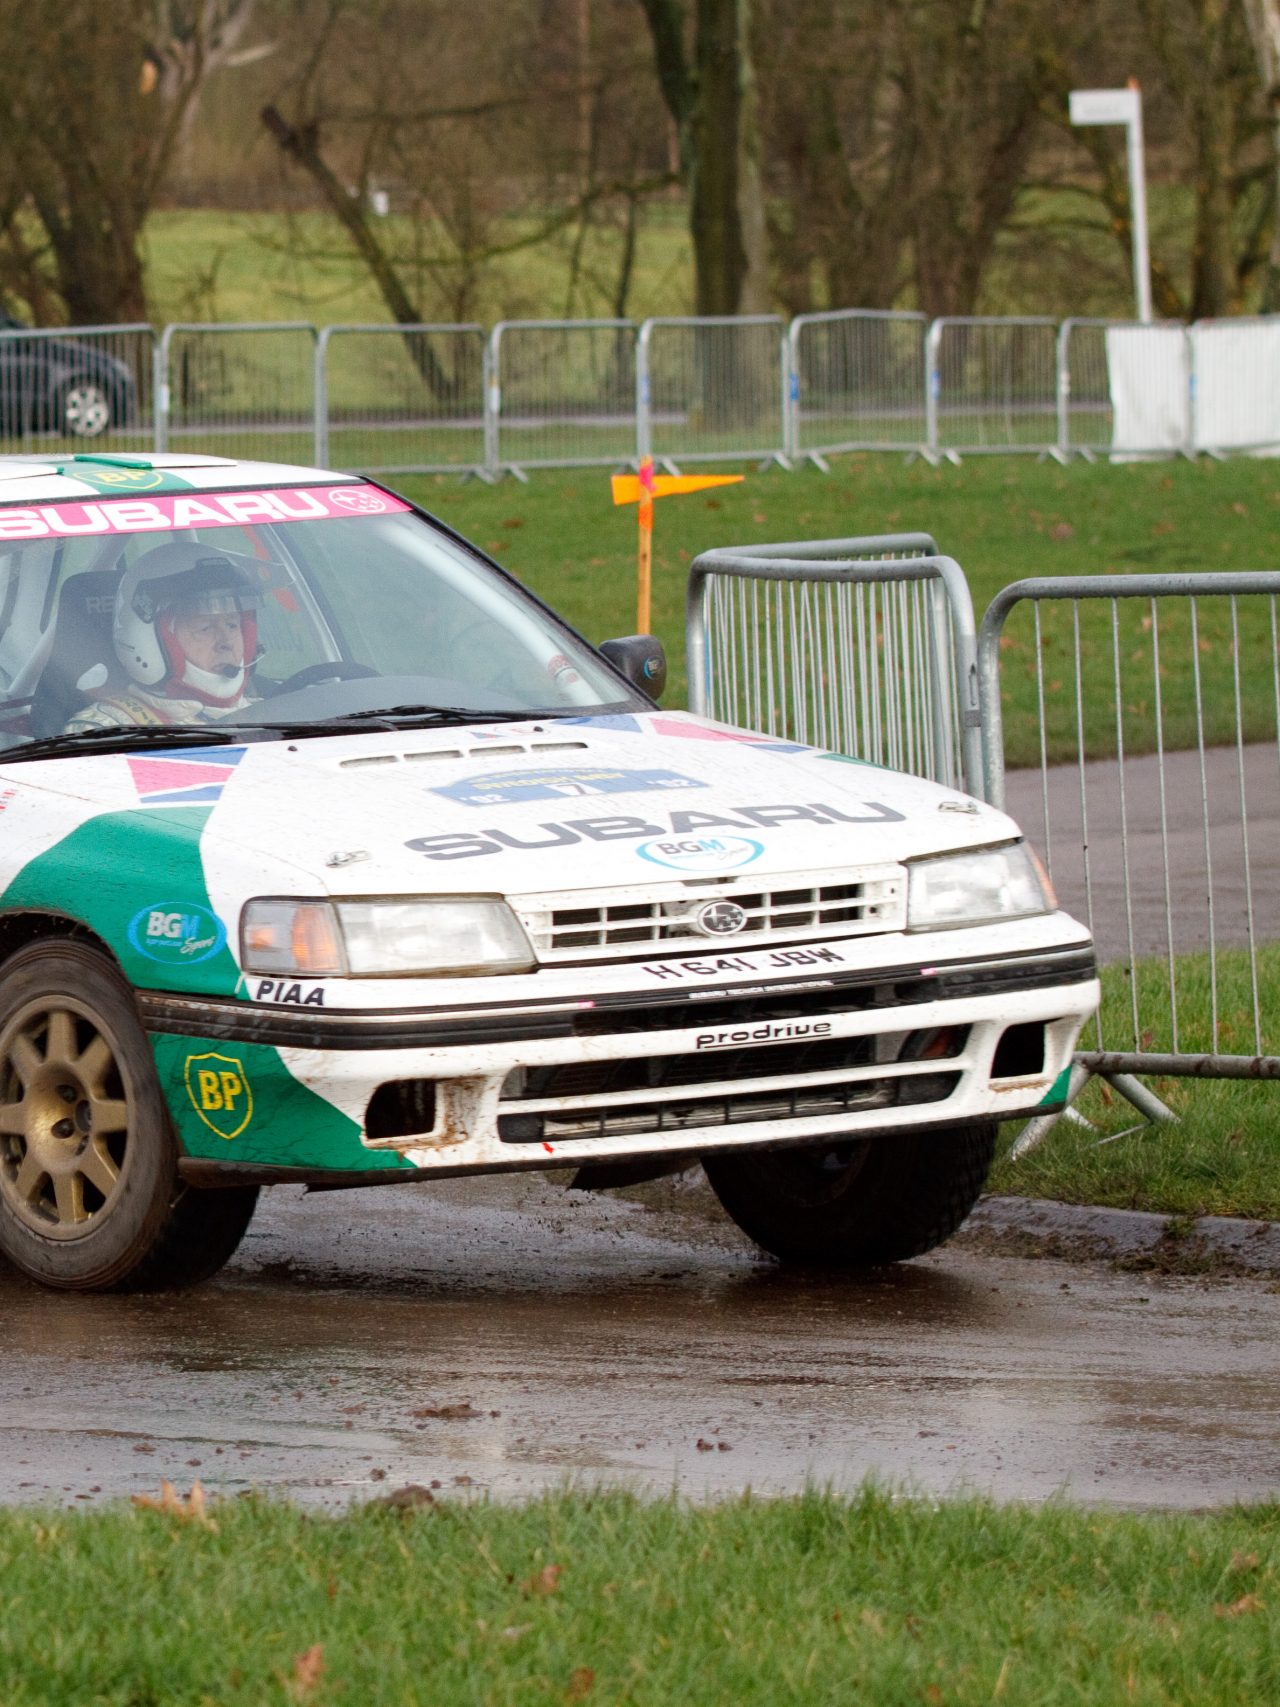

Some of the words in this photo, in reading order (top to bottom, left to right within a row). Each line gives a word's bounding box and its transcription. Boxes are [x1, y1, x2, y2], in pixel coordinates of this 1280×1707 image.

[96, 471, 146, 483] BP
[403, 801, 907, 861] SUBARU
[655, 839, 727, 854] BGM
[146, 911, 200, 938] BGM
[770, 948, 845, 967] JBW
[256, 980, 325, 1006] PIAA
[696, 1022, 832, 1049] prodrive
[197, 1069, 242, 1110] BP
